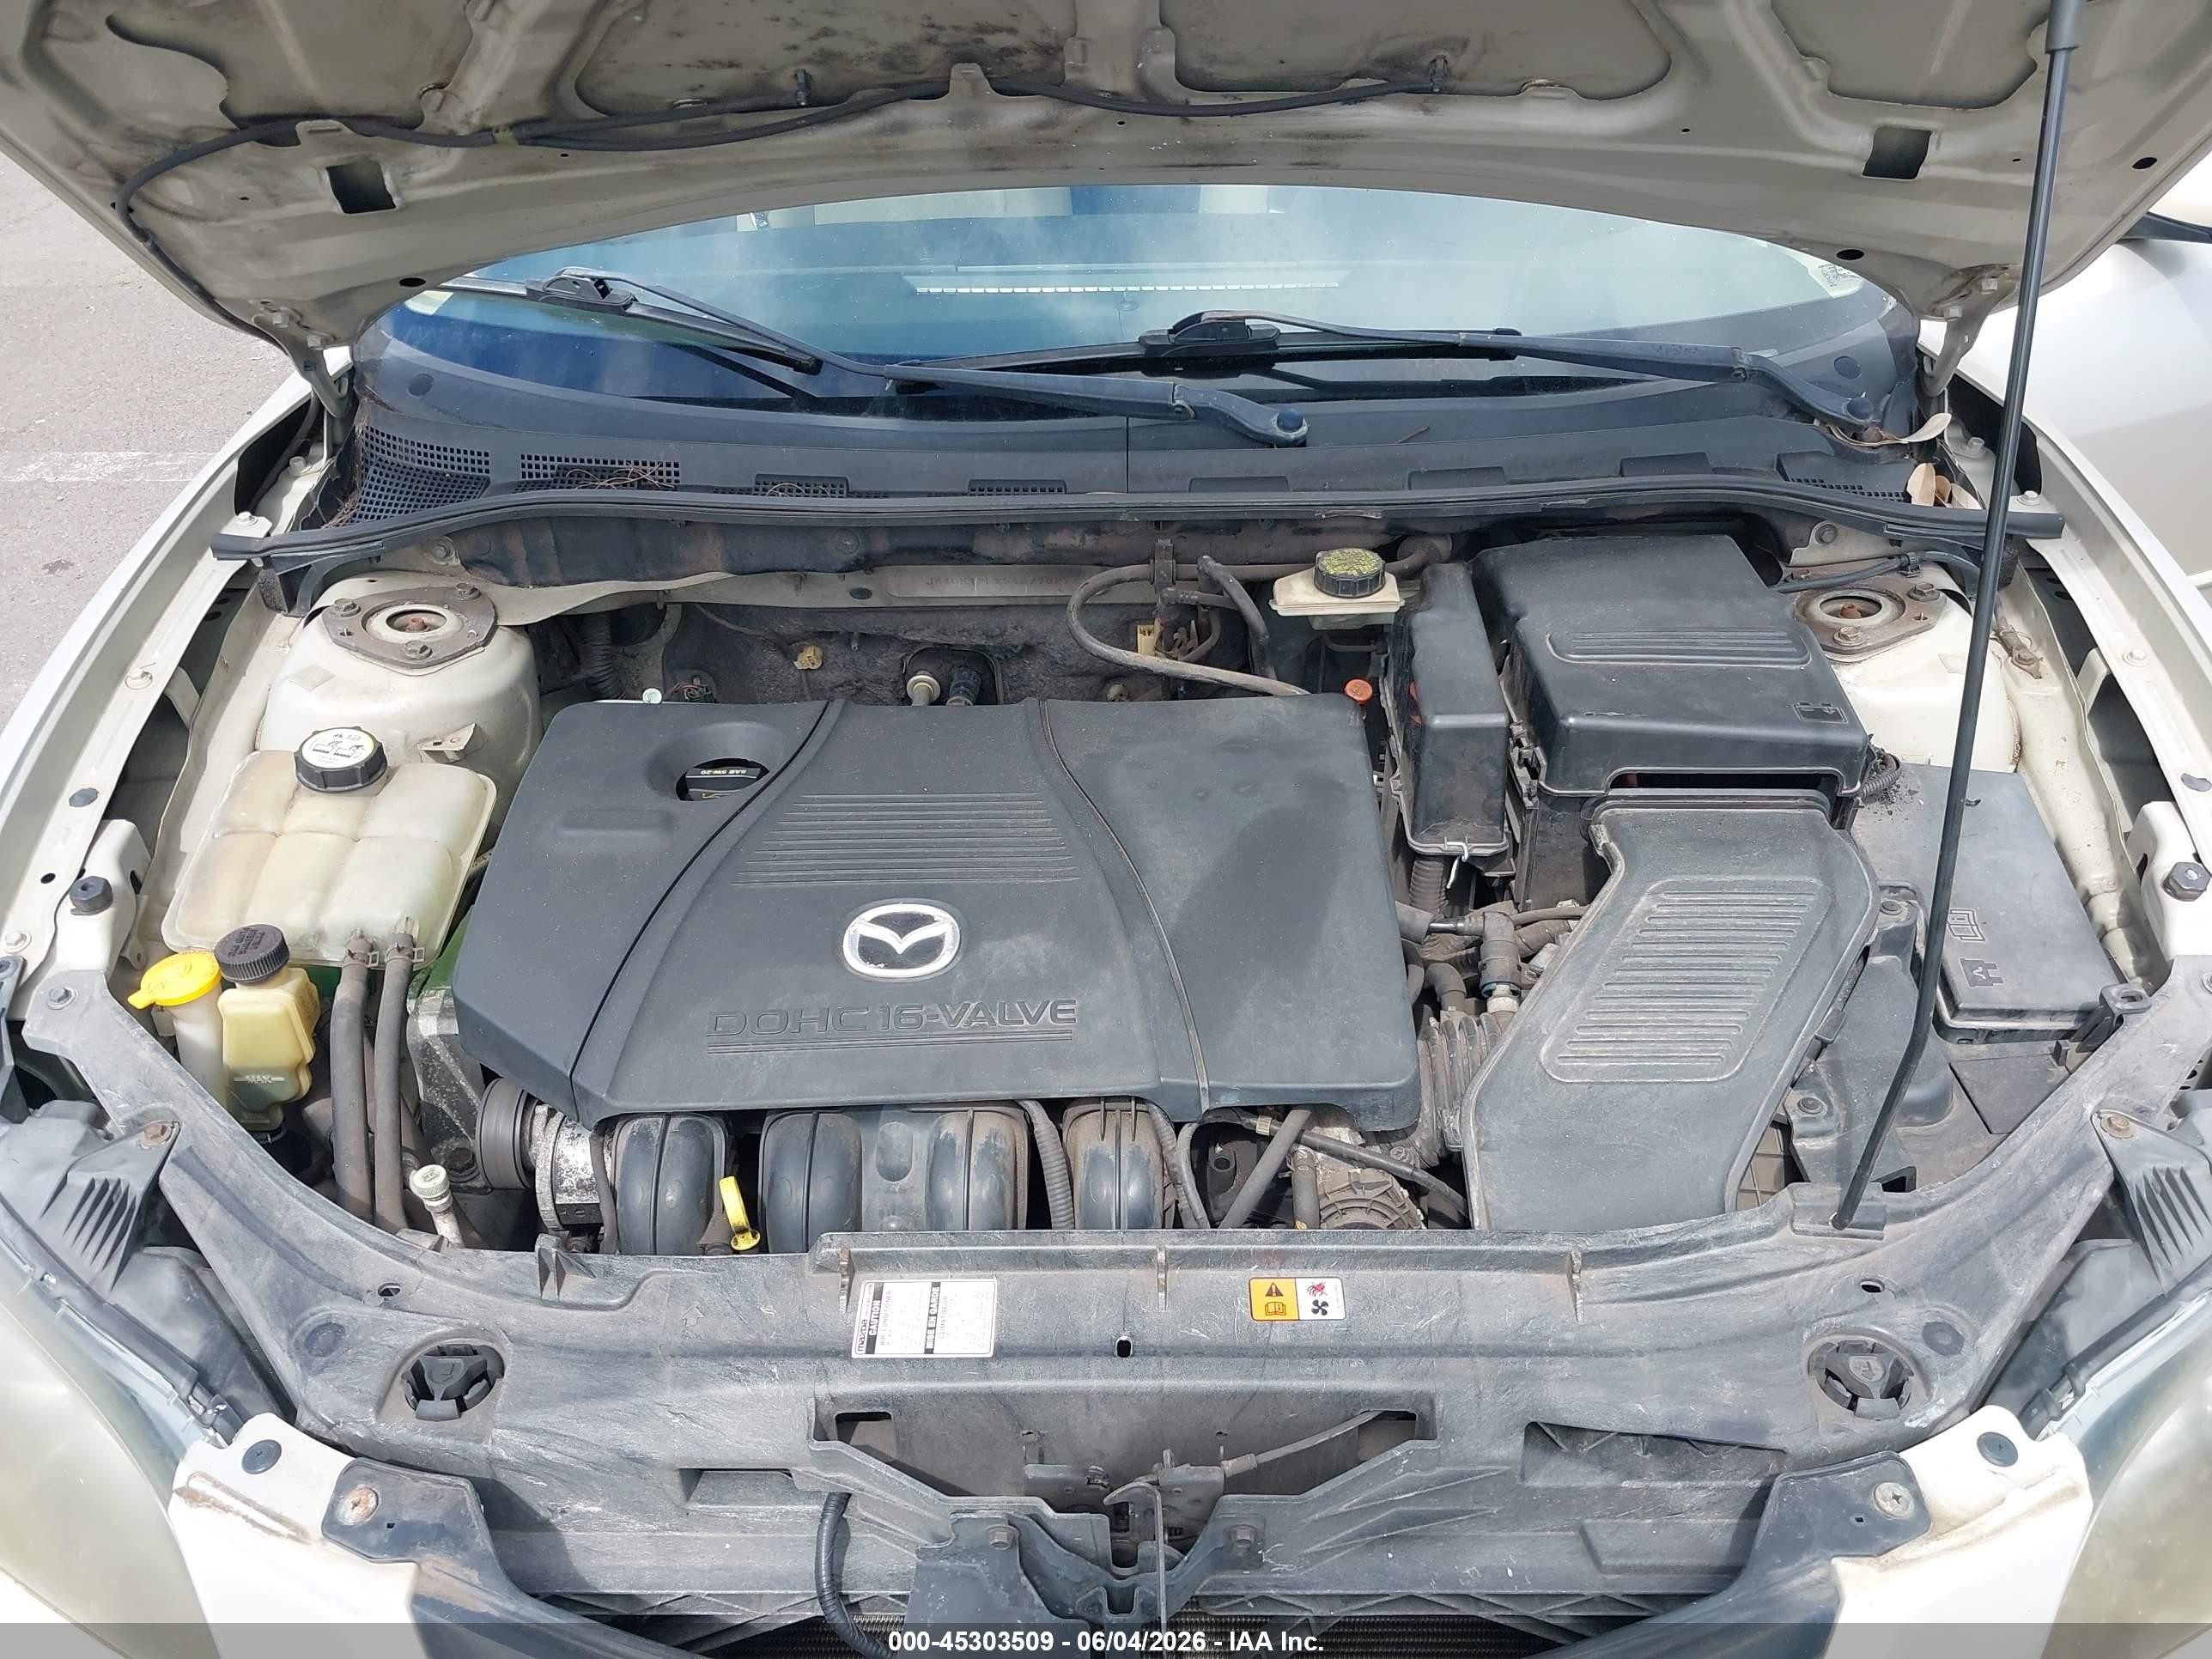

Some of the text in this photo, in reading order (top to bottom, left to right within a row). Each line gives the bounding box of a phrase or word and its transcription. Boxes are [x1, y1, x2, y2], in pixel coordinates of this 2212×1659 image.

[705, 999, 1079, 1036] DOHC 16-VALVE
[246, 1075, 273, 1085] MAX
[858, 1318, 868, 1352] mazda
[868, 1299, 881, 1336] CAUTION
[926, 1286, 940, 1349] MISE EN GARDE
